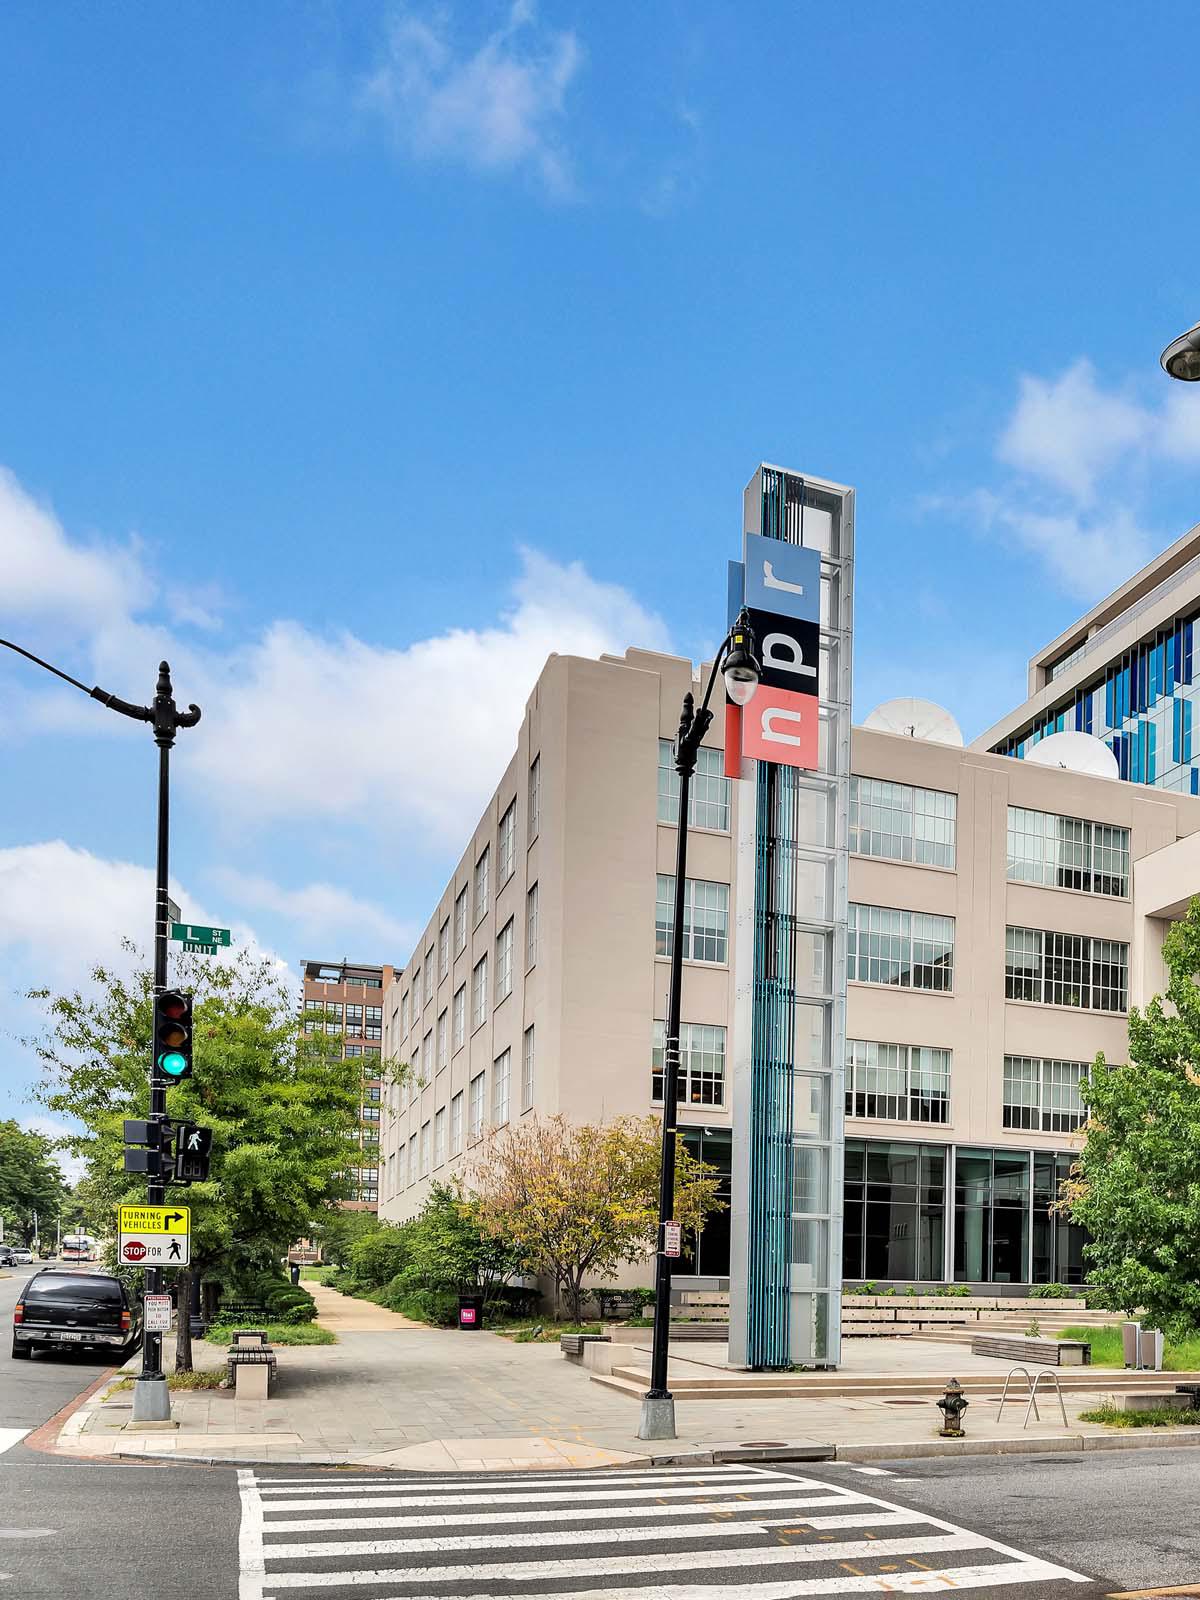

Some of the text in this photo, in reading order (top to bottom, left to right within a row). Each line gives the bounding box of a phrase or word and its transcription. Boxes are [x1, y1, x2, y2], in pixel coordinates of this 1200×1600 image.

[761, 560, 817, 747] npr
[187, 927, 200, 940] L
[123, 1212, 161, 1220] TURNING
[123, 1221, 162, 1229] VEHICLES
[124, 1247, 162, 1256] STOP FOR
